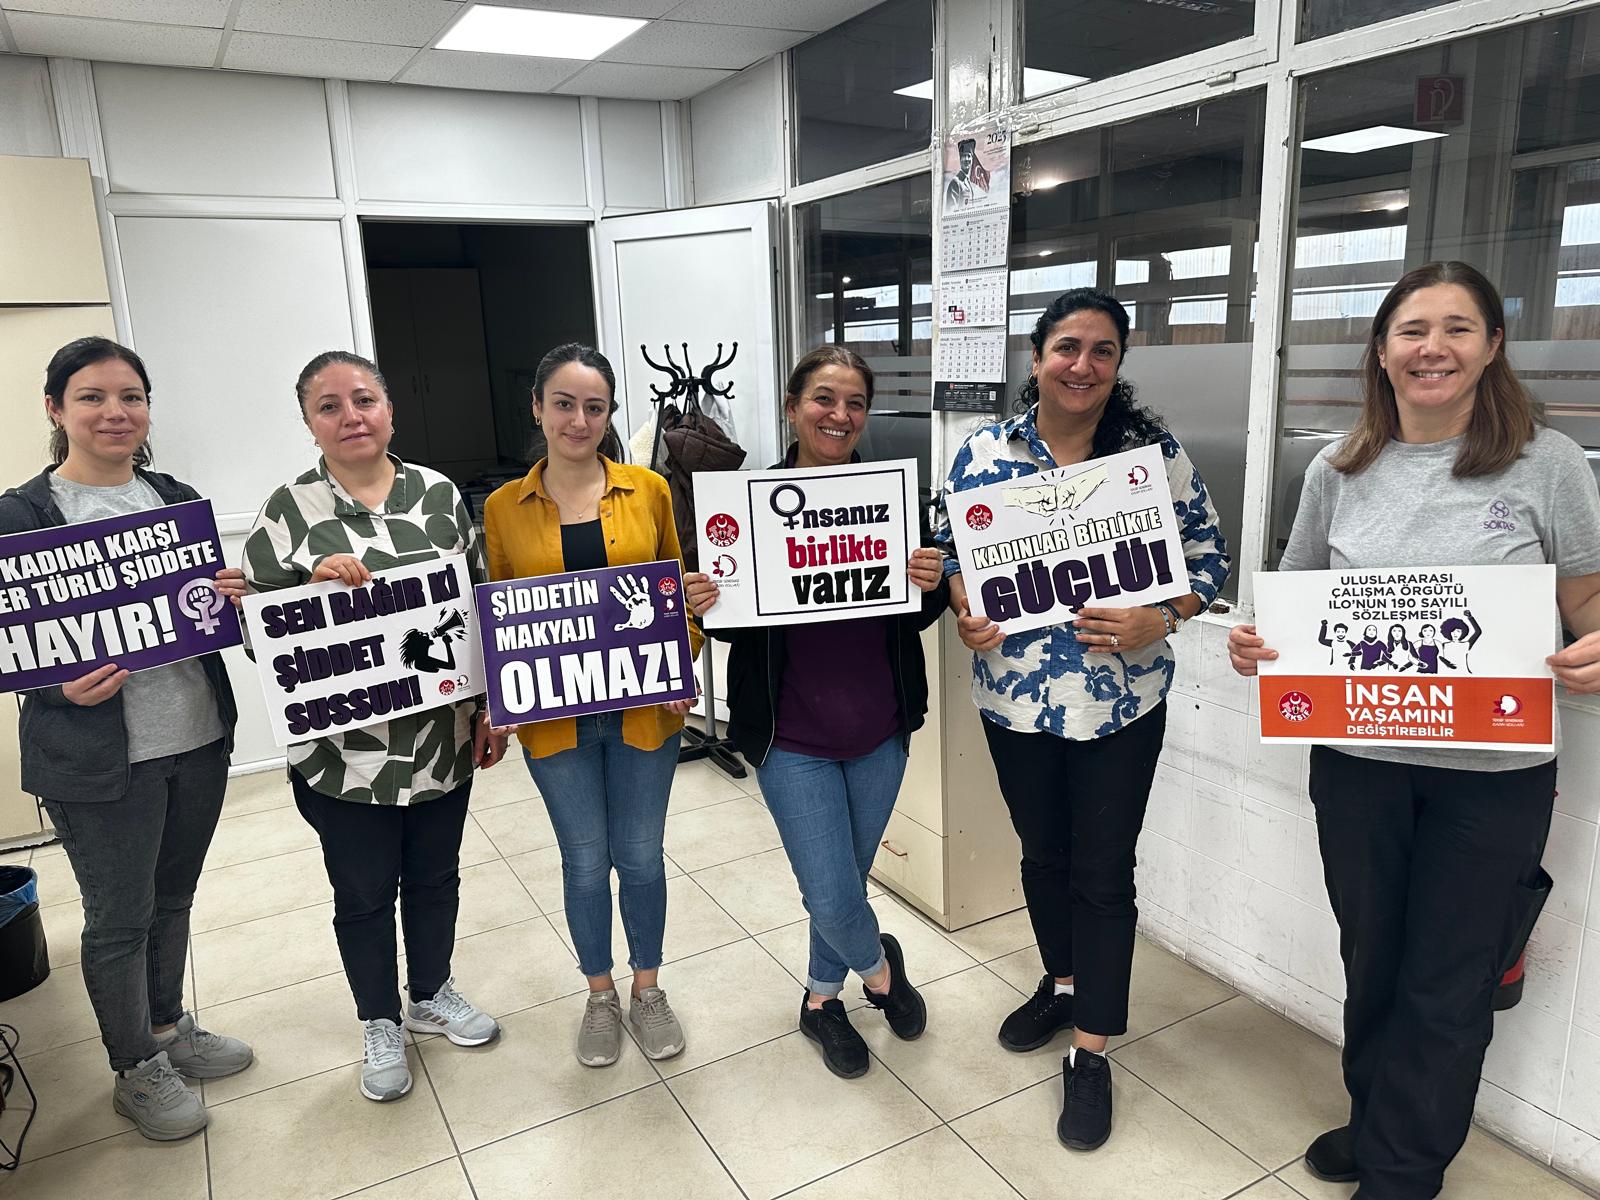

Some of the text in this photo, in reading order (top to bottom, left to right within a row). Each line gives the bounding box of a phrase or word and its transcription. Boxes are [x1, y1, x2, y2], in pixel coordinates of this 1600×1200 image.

[0, 520, 181, 583] KADINA KARŞI
[786, 534, 888, 569] birlikte
[972, 506, 1163, 570] KADINLAR BİRLİKTE
[0, 540, 218, 614] ER TÜRLÜ ŞİDDETE
[792, 565, 891, 605] varız
[981, 537, 1174, 622] GÜÇLÜ!
[1331, 583, 1464, 598] ÇALIŞMA ÖRGÜTÜ
[1340, 573, 1453, 585] ULUSLARARASI
[260, 596, 327, 639] SEN
[328, 577, 426, 626] BAĞIR
[490, 577, 600, 621] ŞİDDETİN
[1352, 608, 1443, 621] SÖZLEŞMESİ
[1391, 598, 1416, 609] 190
[1421, 597, 1467, 608] SAYILI
[0, 594, 178, 675] HAYIR!
[495, 615, 596, 652] MAKYAJI
[273, 634, 386, 693] ŞİDDET
[500, 640, 684, 714] OLMAZ!
[284, 674, 424, 735] SUSSUN!
[1345, 678, 1453, 707] İNSAN
[1345, 707, 1454, 724] YAŞAMINI
[1346, 724, 1454, 737] DEĞİŞTİREBİLİR
